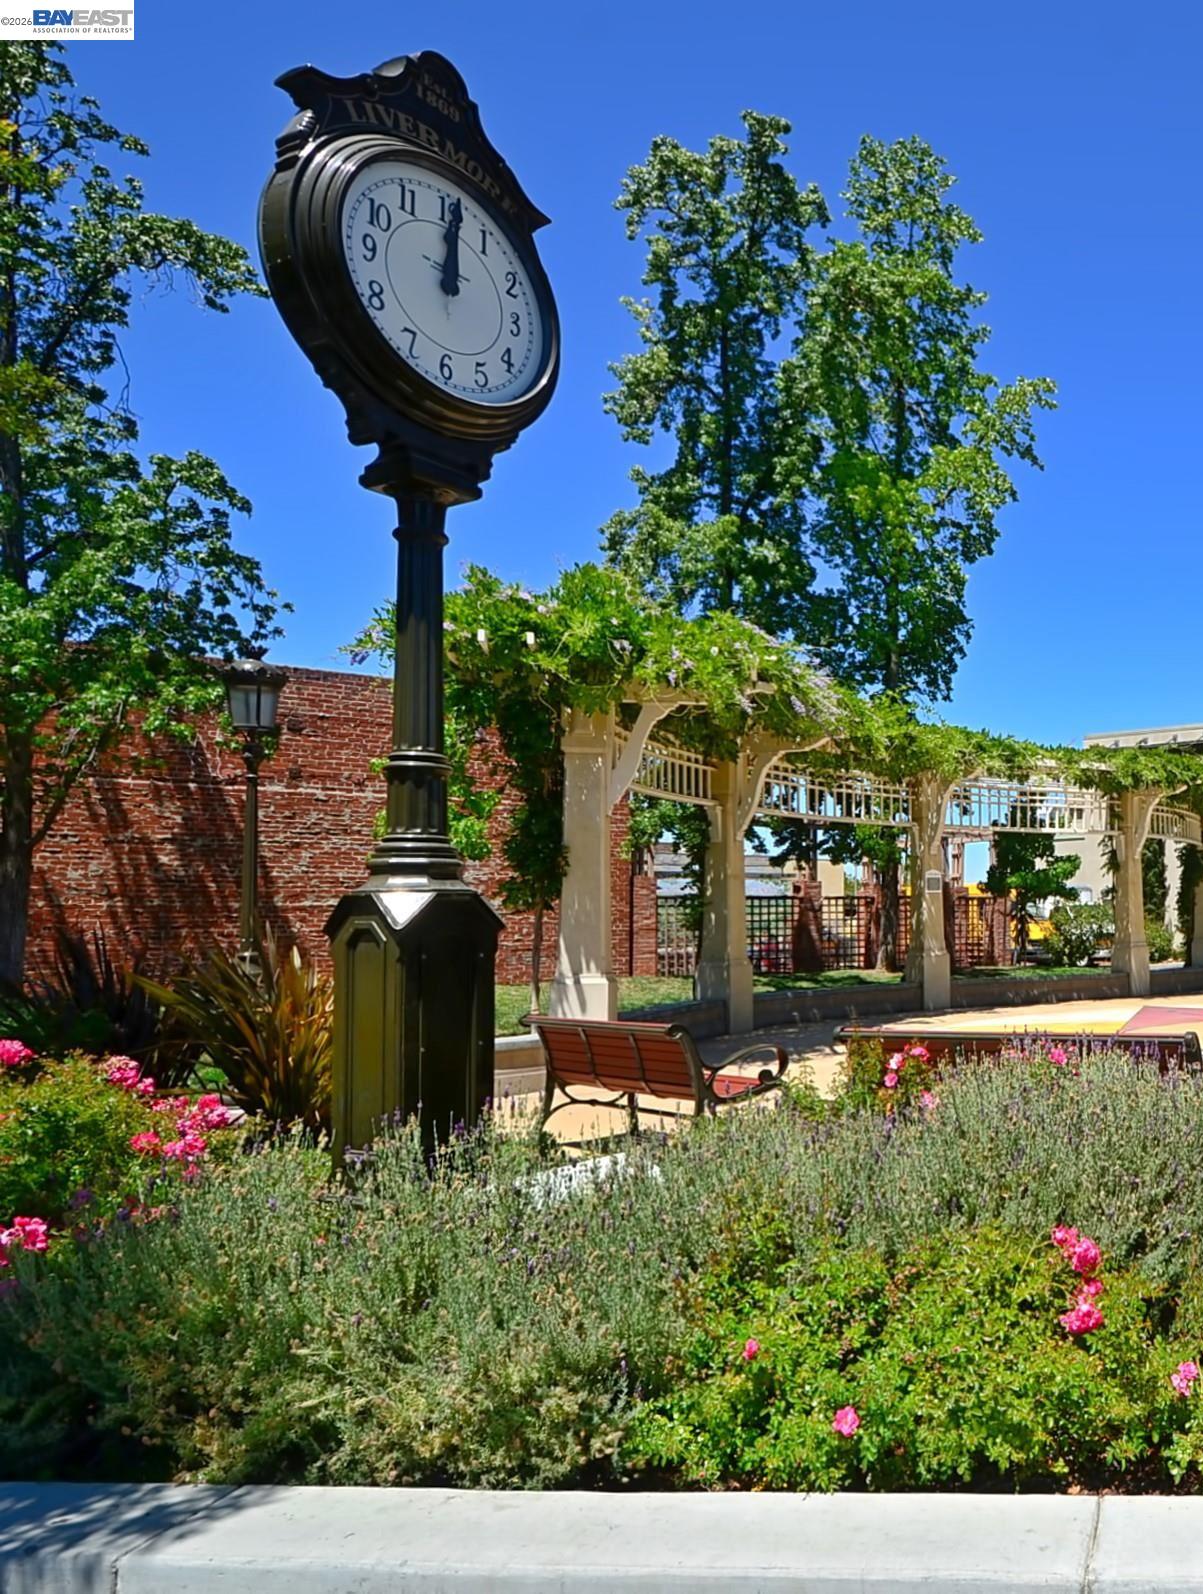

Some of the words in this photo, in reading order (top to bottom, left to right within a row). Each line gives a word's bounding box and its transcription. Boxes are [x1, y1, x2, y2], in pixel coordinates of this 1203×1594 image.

[398, 183, 417, 218] 11
[368, 197, 392, 233] 10
[362, 233, 377, 262] 9
[479, 228, 488, 256] 1
[368, 280, 385, 311] 8
[505, 272, 518, 299] 2
[510, 312, 521, 338] 3
[401, 326, 420, 359] 7
[439, 353, 453, 381] 6
[501, 347, 514, 374] 4
[475, 362, 489, 389] 5
